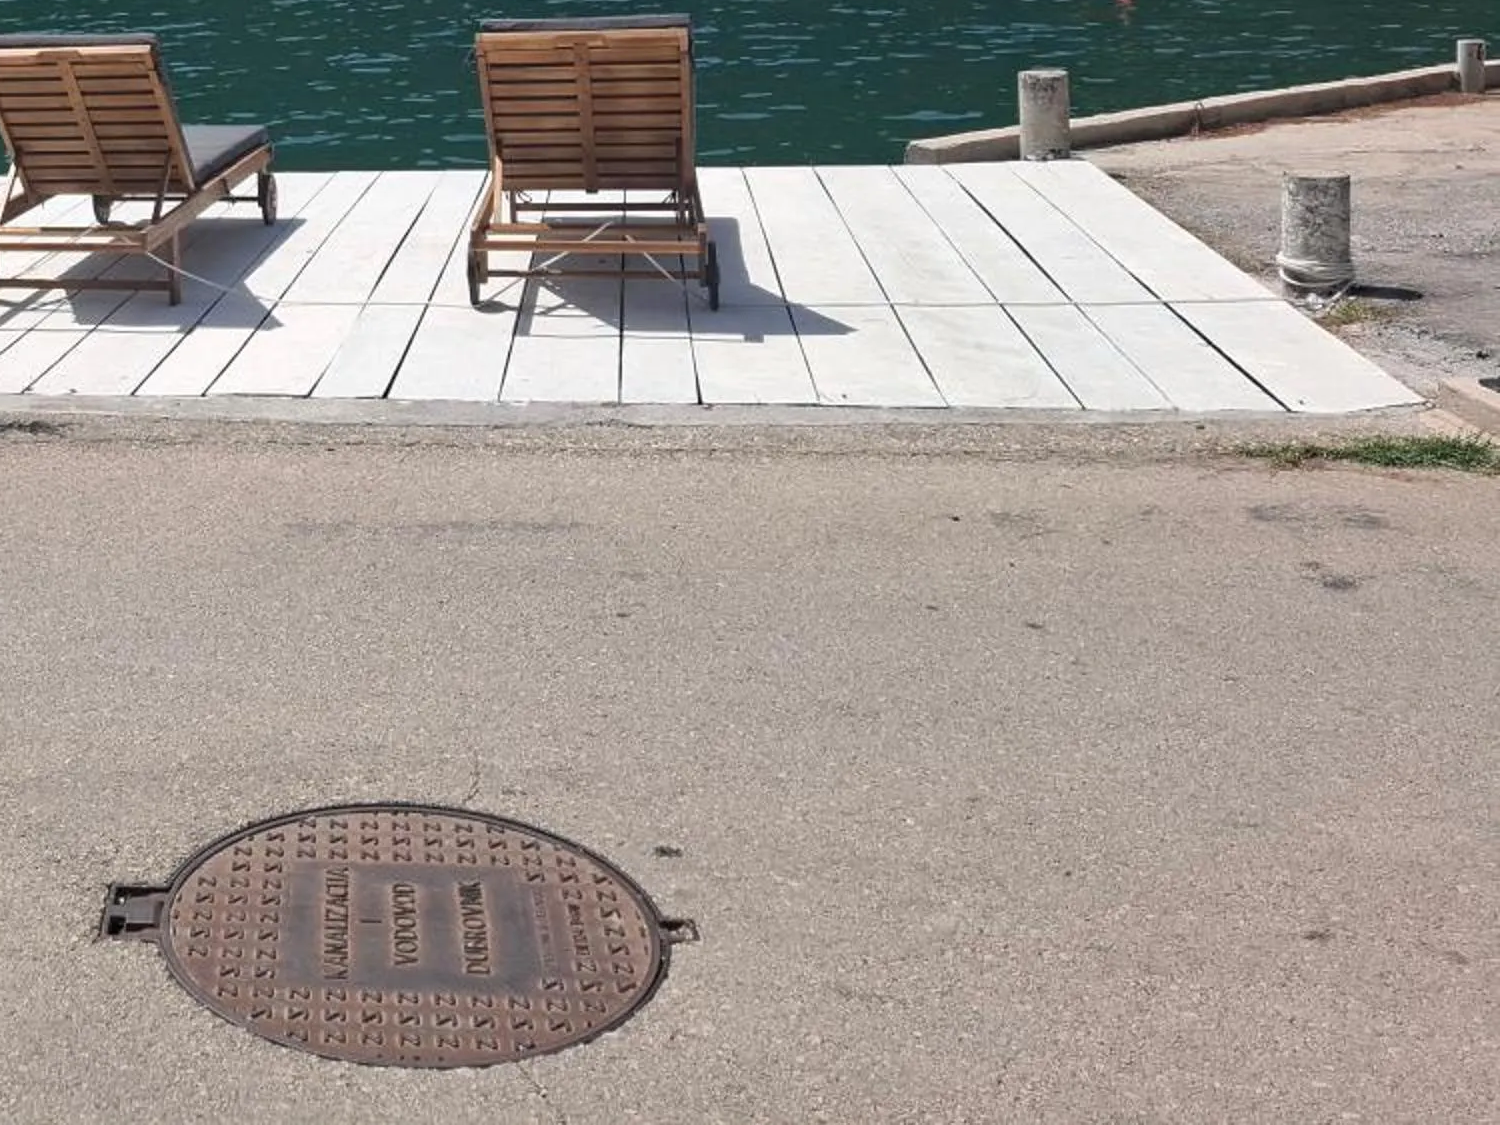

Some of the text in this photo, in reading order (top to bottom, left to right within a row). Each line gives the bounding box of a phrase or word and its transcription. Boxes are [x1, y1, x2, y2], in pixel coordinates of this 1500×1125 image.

[323, 867, 349, 980] KANALIZACIJA
[392, 883, 419, 966] VODOVOD
[457, 881, 490, 975] DUBROVNIK
